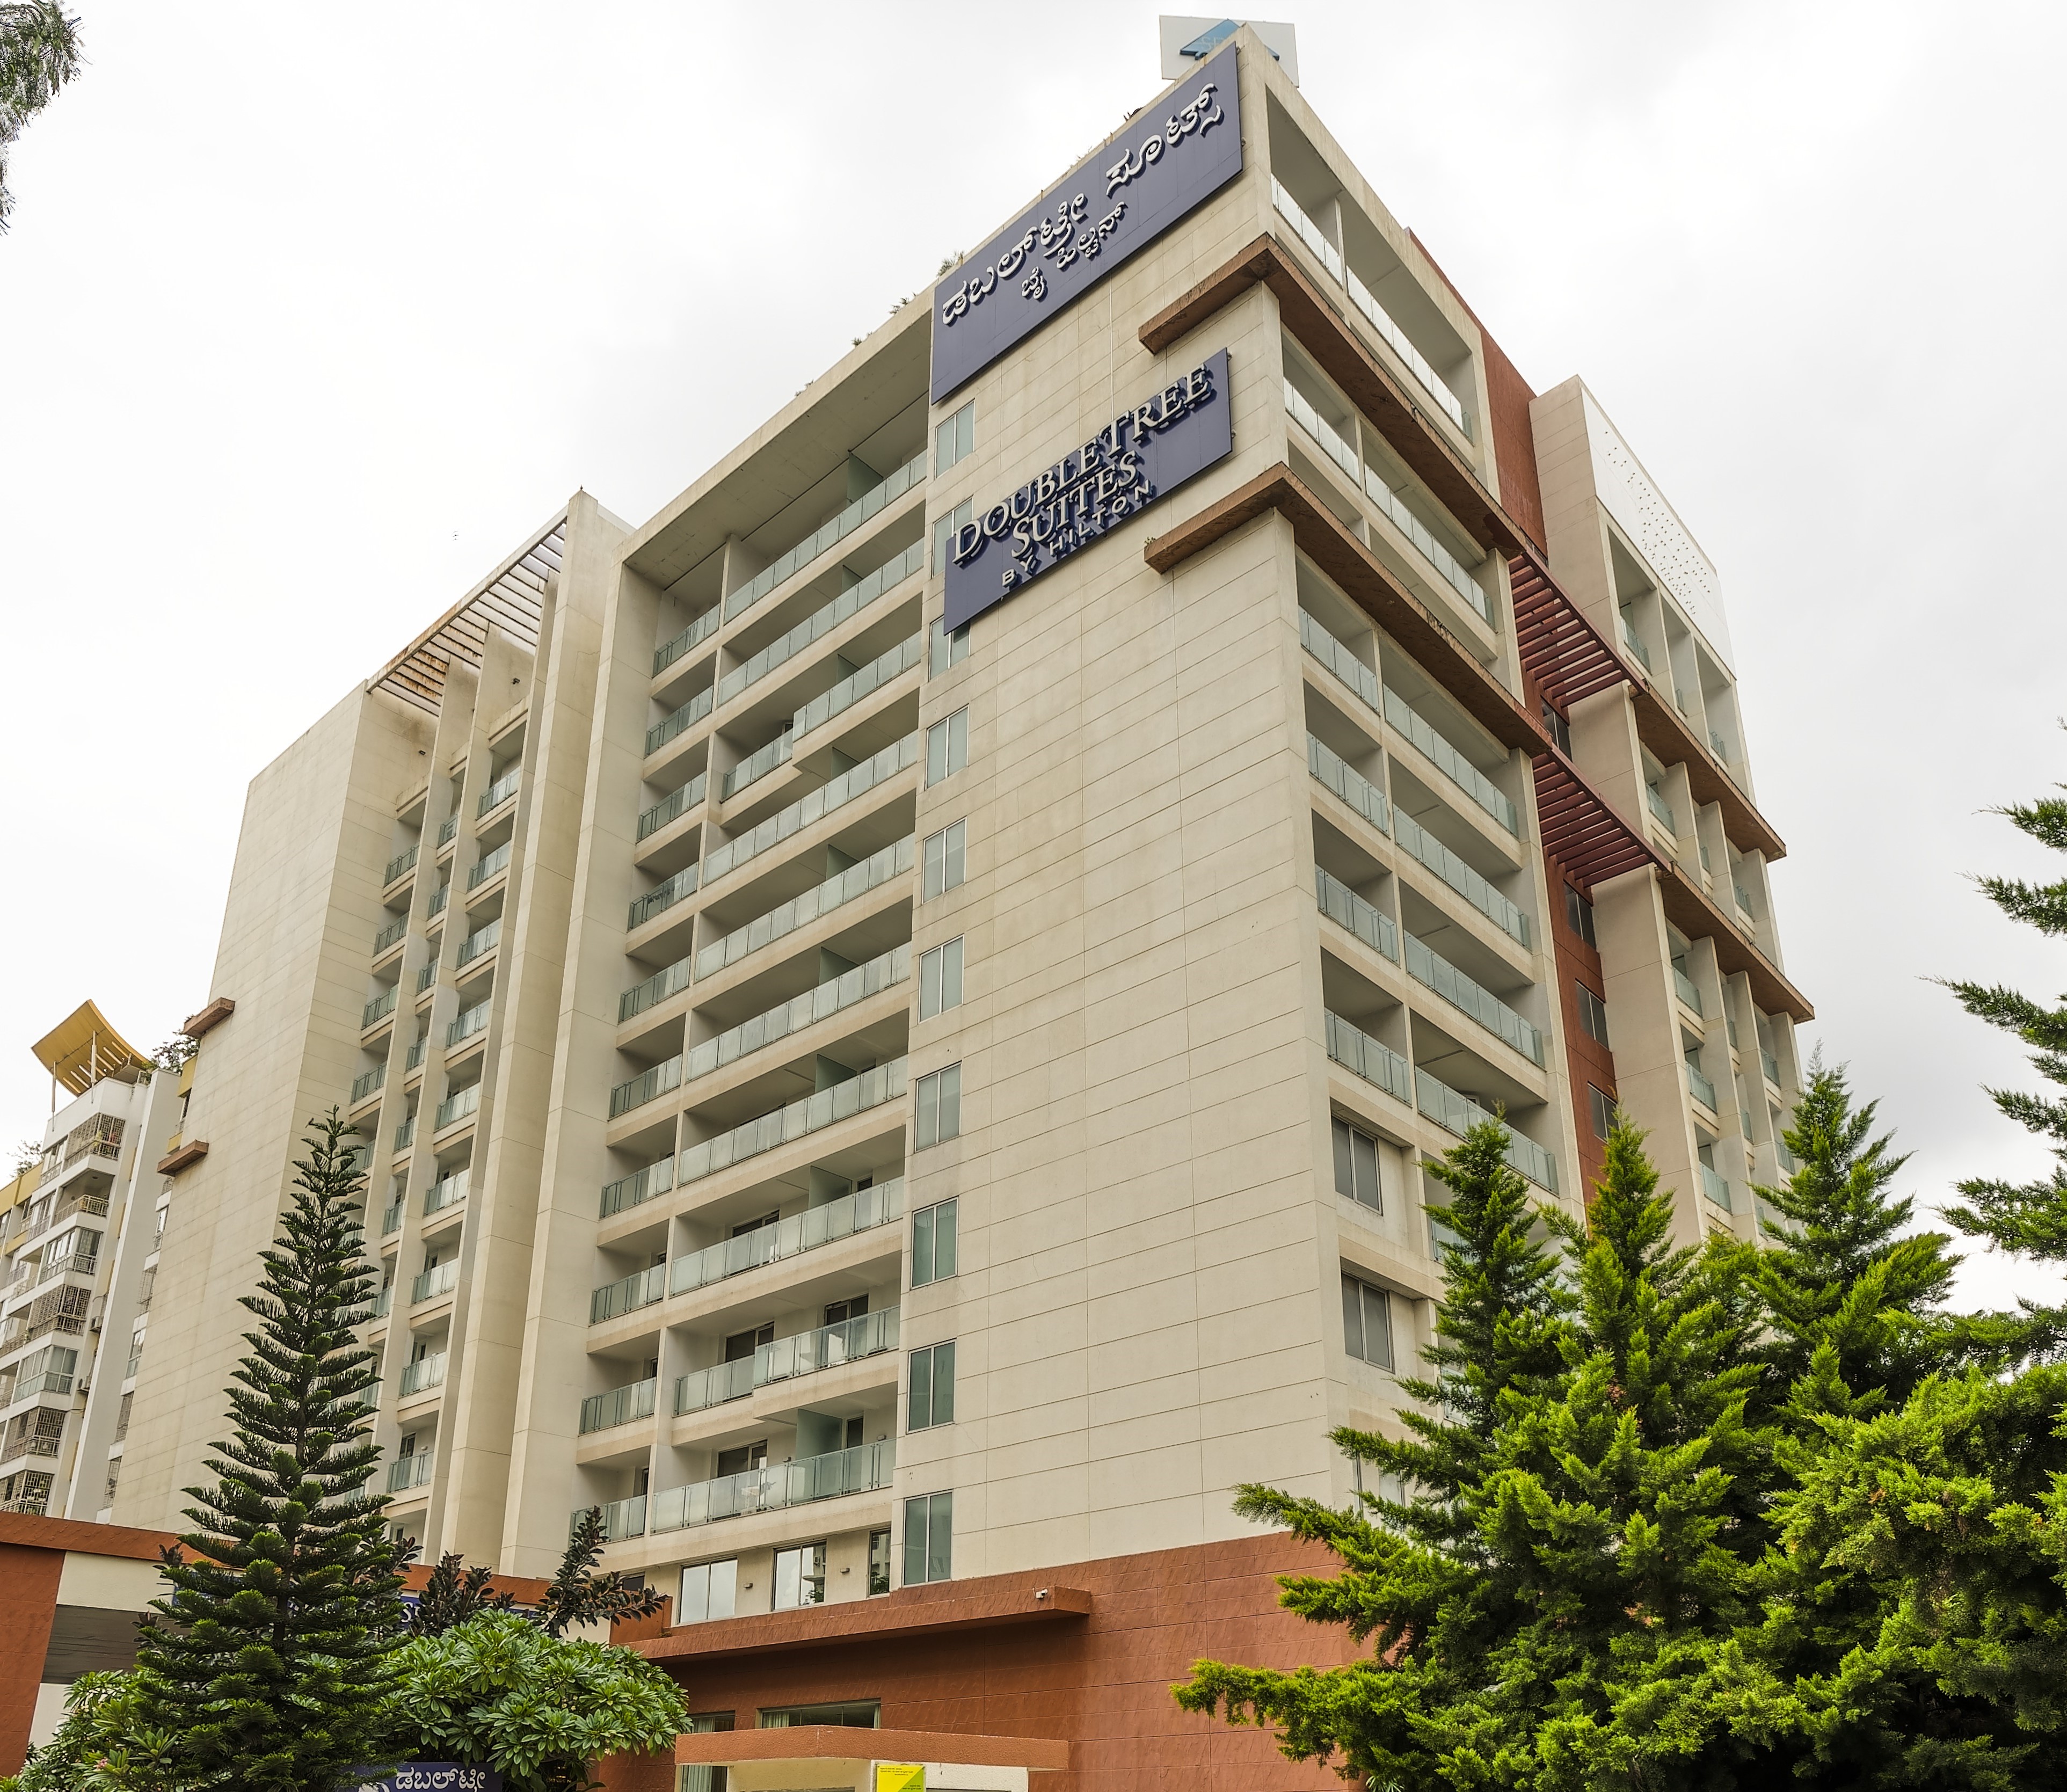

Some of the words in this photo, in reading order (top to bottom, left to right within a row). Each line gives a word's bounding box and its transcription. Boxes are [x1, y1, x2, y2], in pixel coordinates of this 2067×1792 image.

[1107, 83, 1222, 196] ಸೂಟ್ಸ್
[1021, 266, 1045, 300] ಬೈ
[1057, 201, 1127, 269] ಹಿಲ್ಟನ್
[952, 363, 1210, 565] DOUBLETREE
[1011, 450, 1138, 558] SUITES
[1002, 554, 1035, 587] BY
[1050, 479, 1152, 557] HILTON
